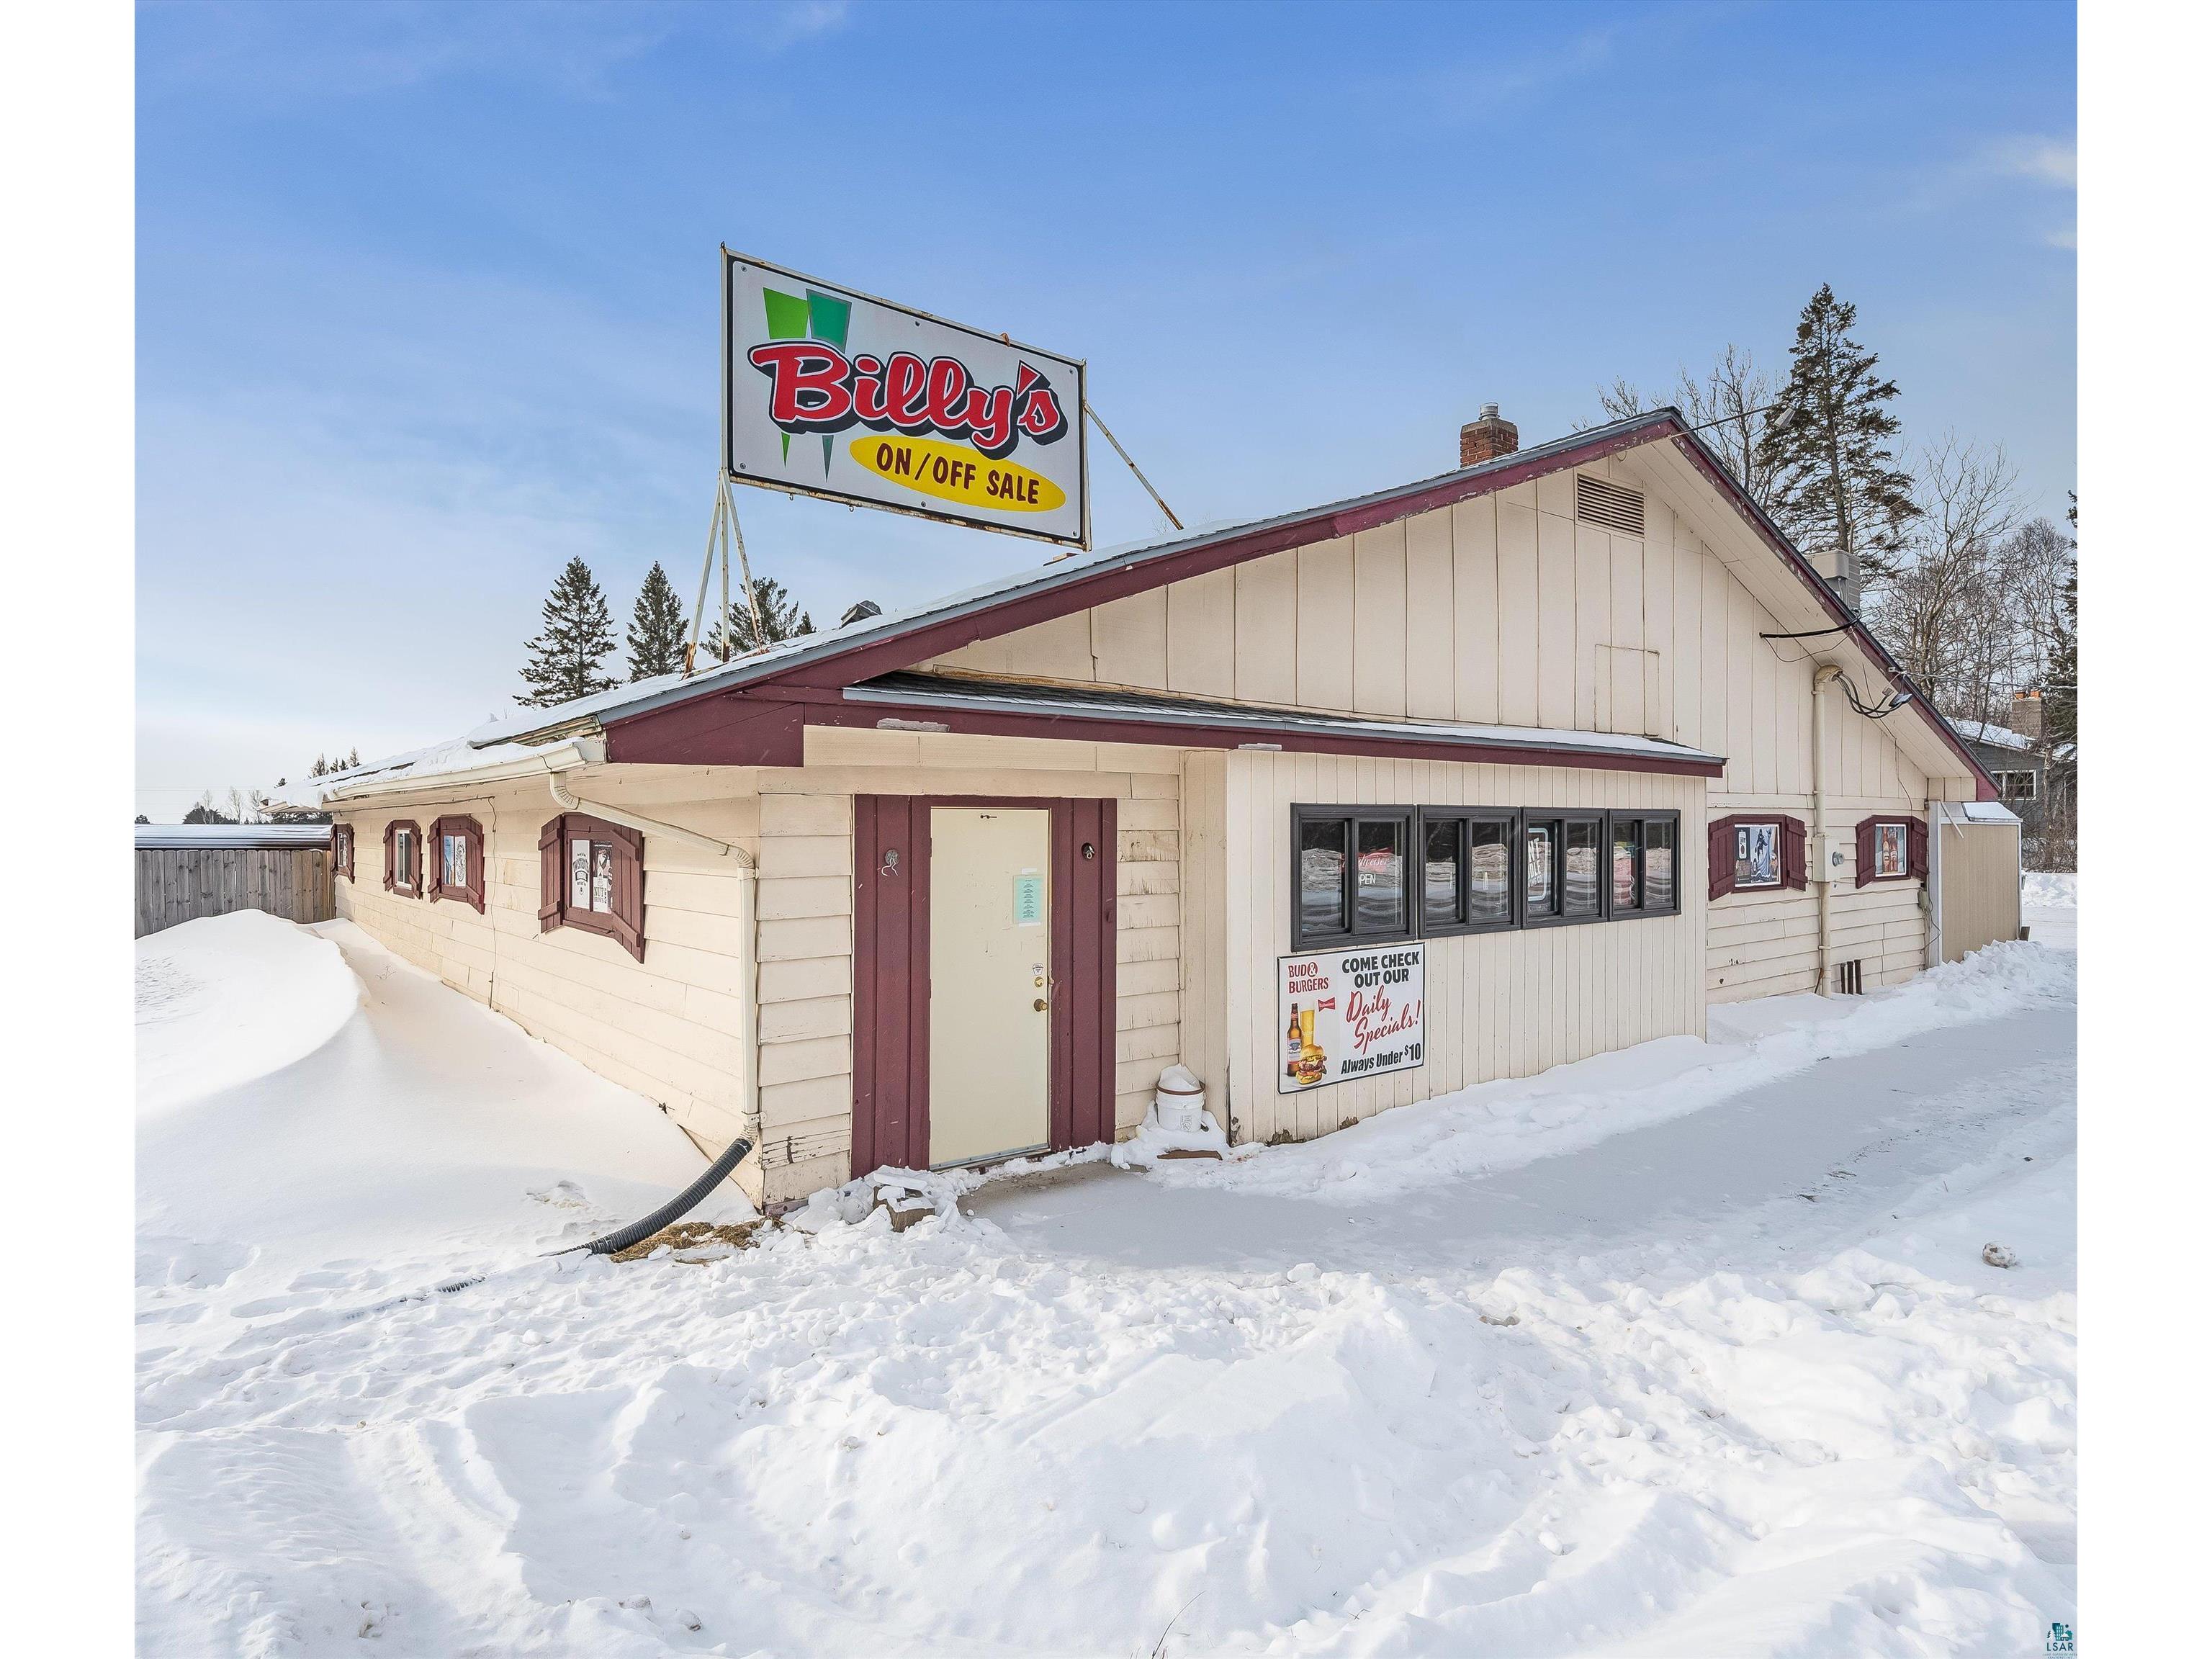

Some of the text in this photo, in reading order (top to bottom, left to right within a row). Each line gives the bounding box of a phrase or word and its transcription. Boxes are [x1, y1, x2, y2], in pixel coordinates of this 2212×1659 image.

[747, 341, 1067, 459] Billy's
[986, 469, 1039, 504] SALE
[1358, 873, 1376, 886] PEN
[1342, 951, 1420, 973] COME CHECK
[1289, 977, 1329, 994] BURGERS
[1354, 968, 1409, 988] OUT OUR
[1346, 984, 1391, 1022] Daily
[1354, 999, 1421, 1056] Specials!
[1341, 1043, 1421, 1074] Always Under $10
